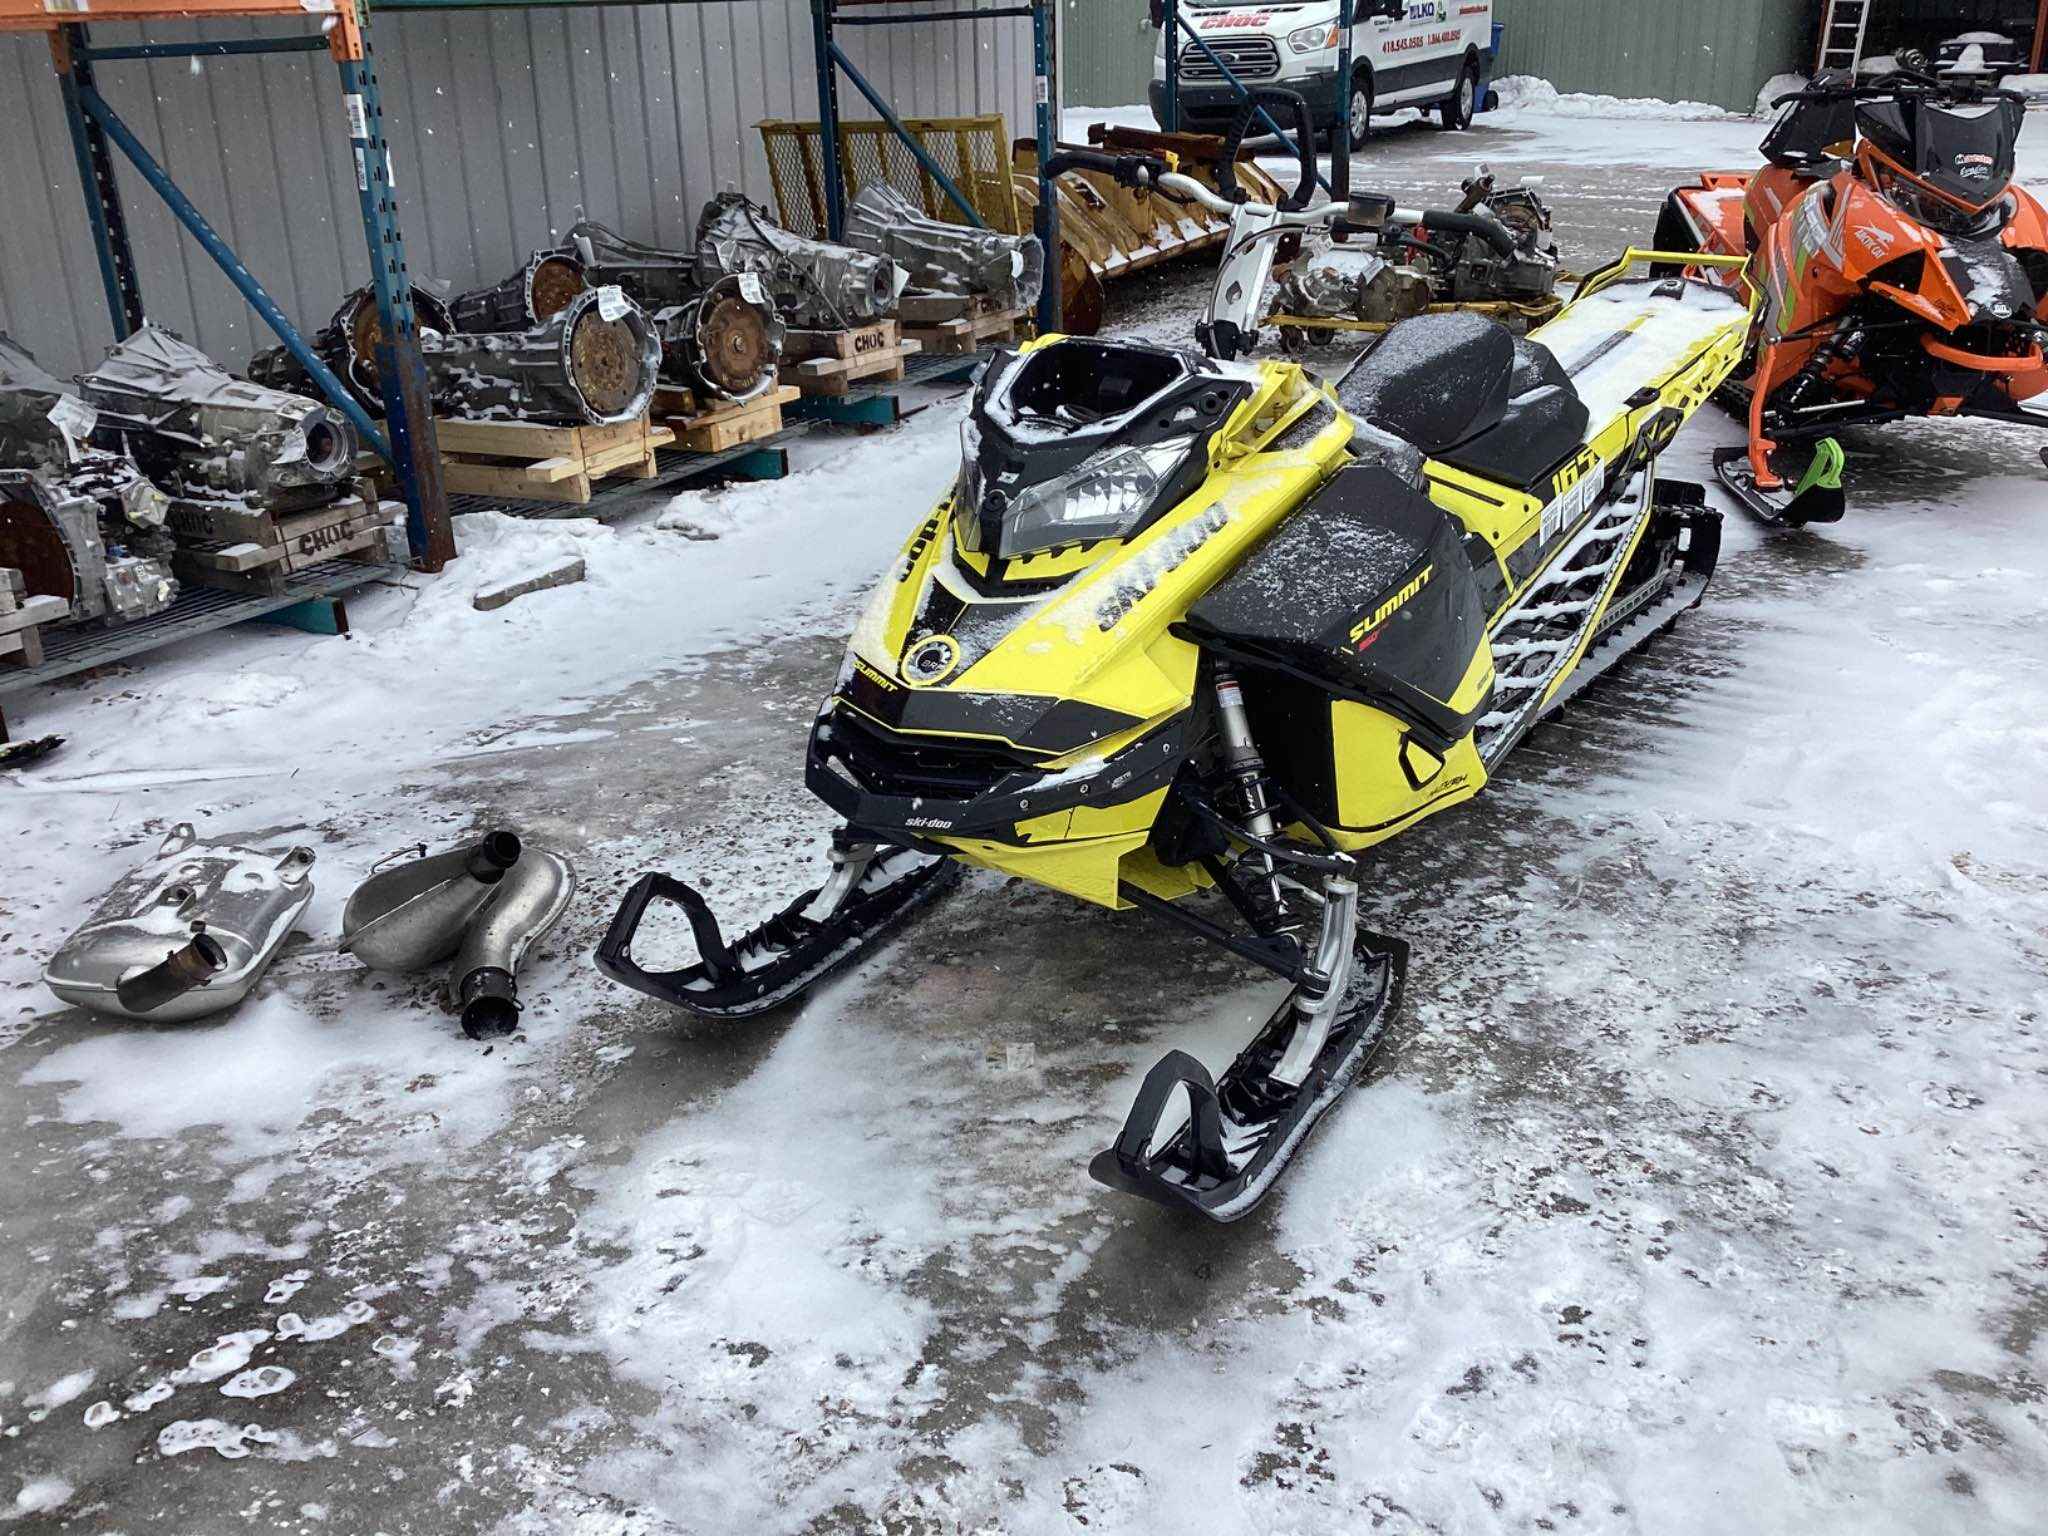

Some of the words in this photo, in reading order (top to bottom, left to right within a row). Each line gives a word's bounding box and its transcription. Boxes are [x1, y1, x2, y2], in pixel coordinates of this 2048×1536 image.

[1200, 14, 1271, 29] CHOC
[854, 331, 885, 352] CHOC
[299, 520, 354, 556] CHOC
[1349, 563, 1434, 644] SUMMIT
[853, 659, 899, 693] SUMMIT
[905, 816, 953, 830] ski-doo
